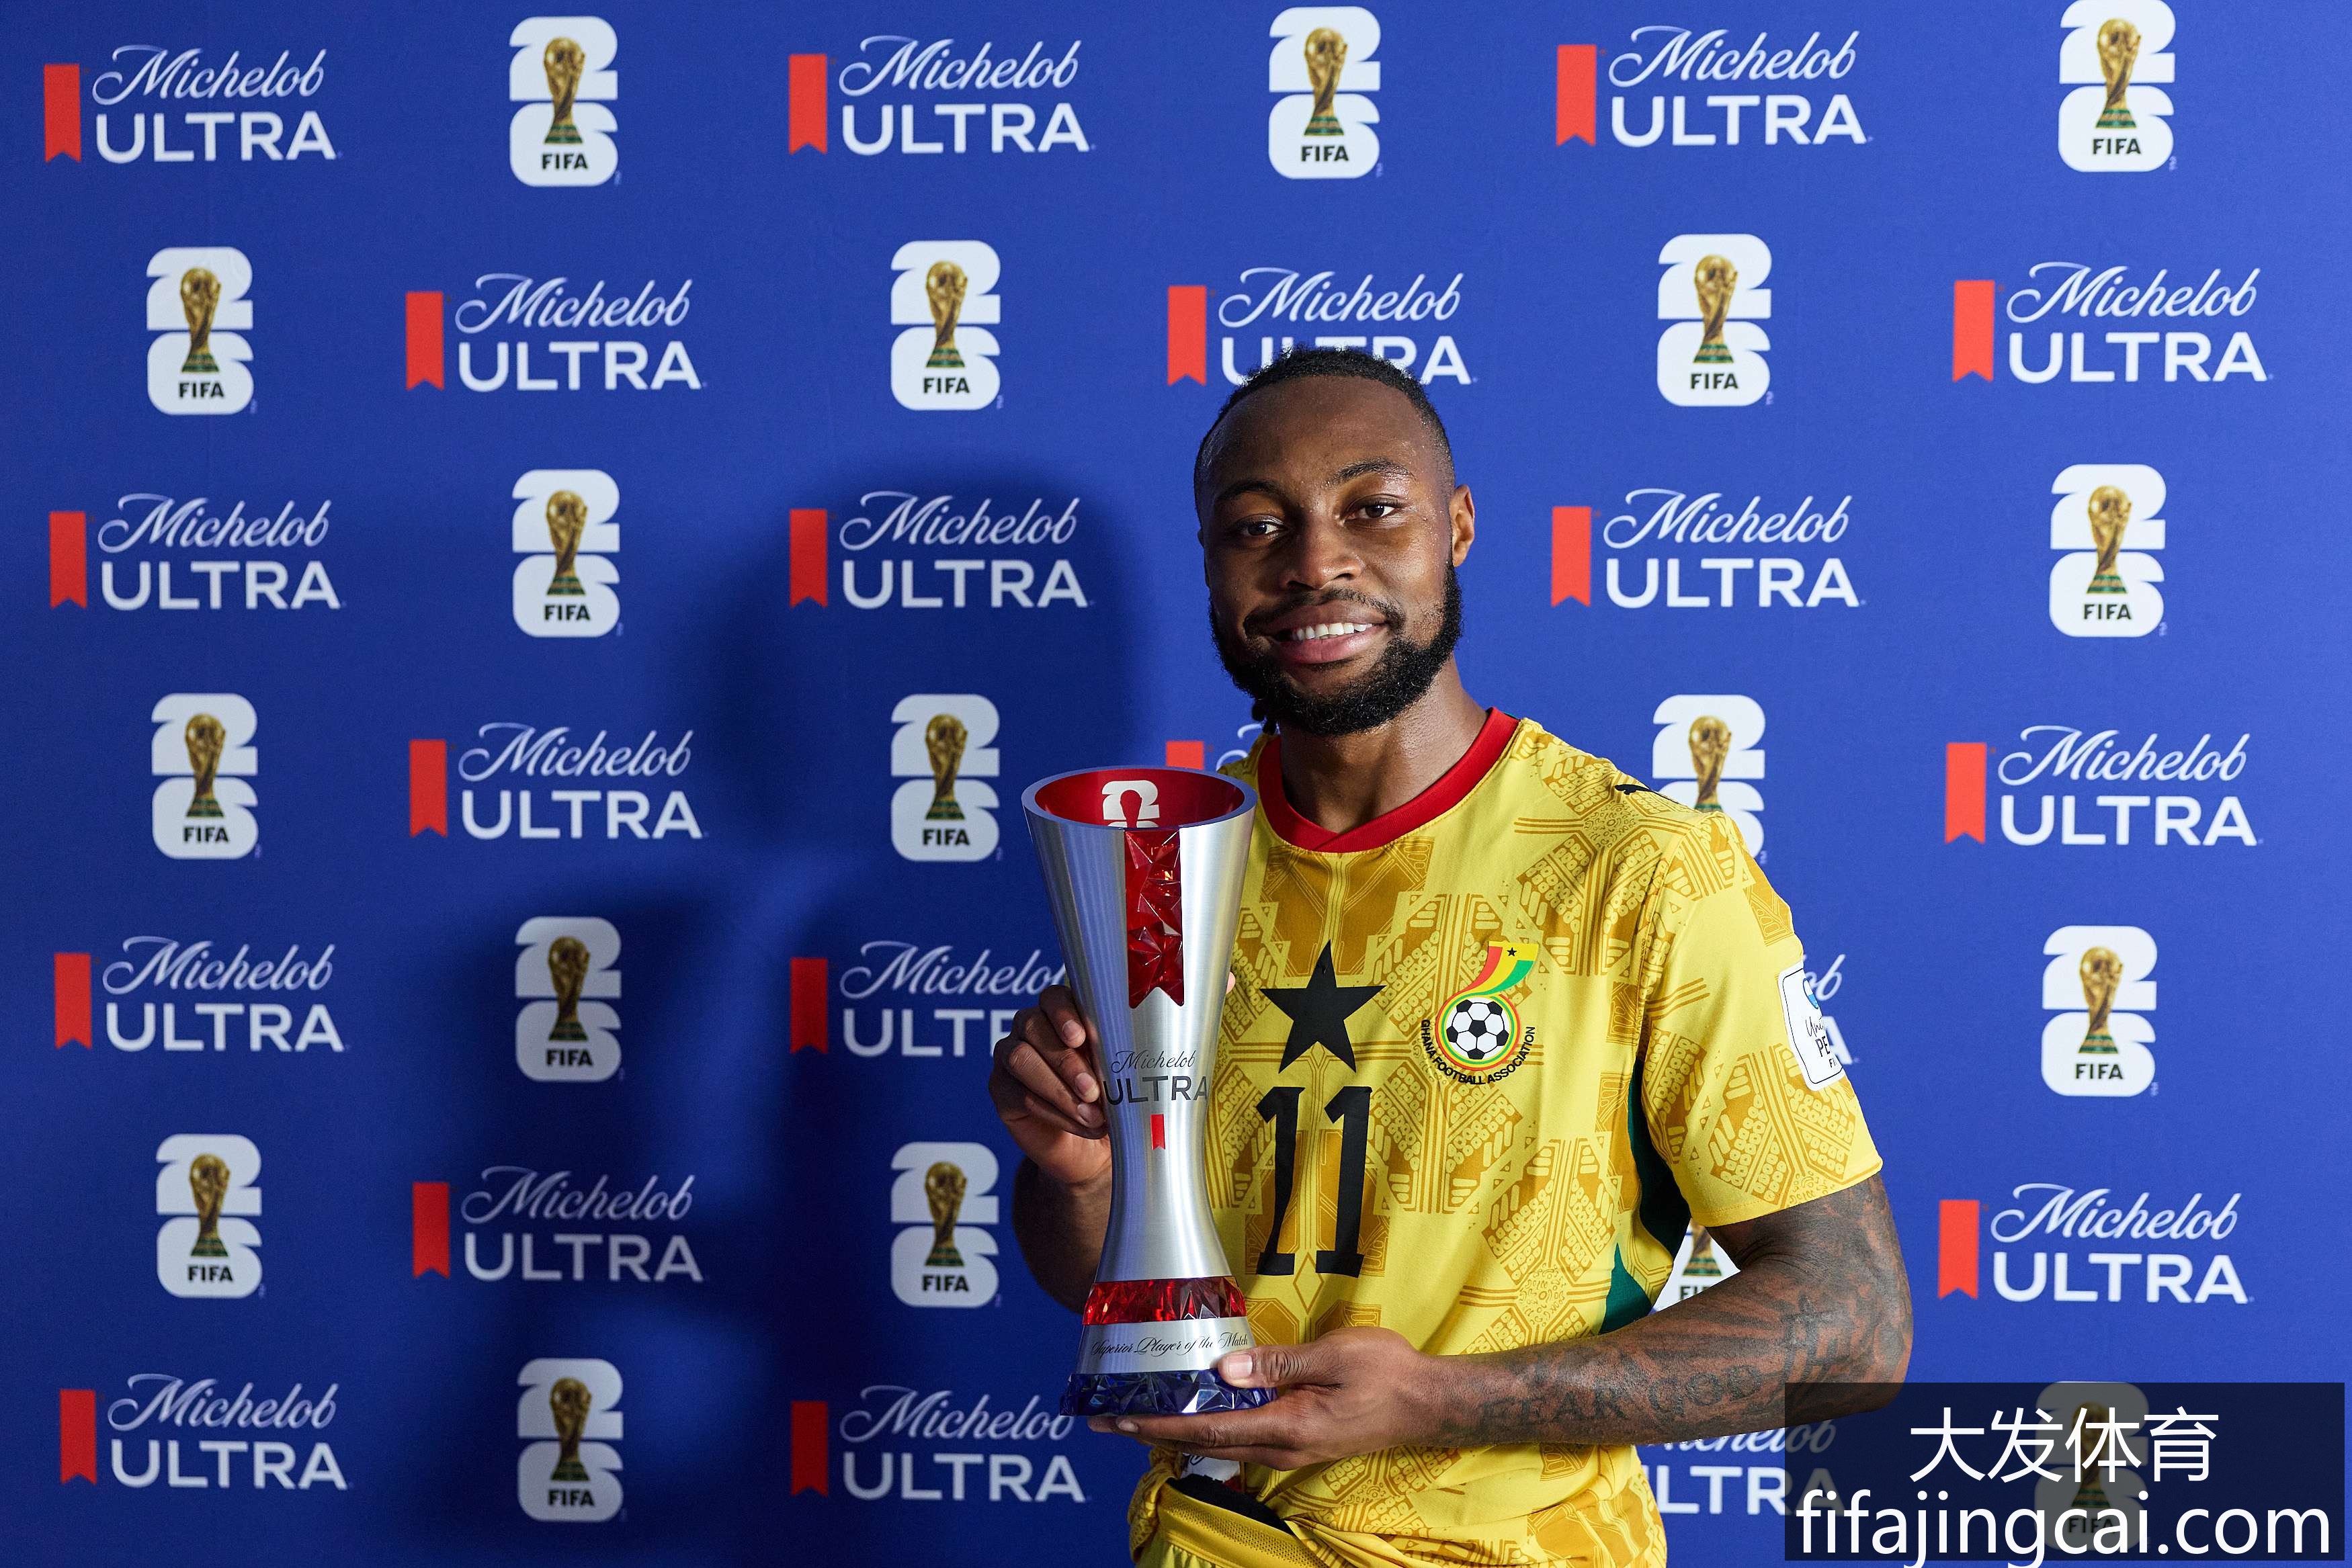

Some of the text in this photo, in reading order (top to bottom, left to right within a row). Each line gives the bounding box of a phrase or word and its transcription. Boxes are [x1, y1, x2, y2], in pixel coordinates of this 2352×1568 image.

[92, 46, 326, 105] Michelob
[839, 36, 1081, 96] Michelob
[1609, 26, 1859, 87] Michelob
[97, 112, 335, 163] ULTRA
[843, 103, 1089, 155] ULTRA
[1612, 95, 1866, 147] ULTRA
[542, 154, 587, 169] FIFA
[1302, 146, 1349, 161] FIFA
[2093, 138, 2141, 155] FIFA
[455, 273, 692, 333] Michelob
[1219, 267, 1463, 327] Michelob
[2007, 262, 2260, 323] Michelob
[459, 341, 701, 392] ULTRA
[1691, 374, 1738, 389] FIFA
[2010, 332, 2267, 383] ULTRA
[179, 382, 224, 398] FIFA
[924, 378, 970, 393] FIFA
[98, 494, 331, 553] Michelob
[839, 491, 1079, 550] Michelob
[1603, 488, 1852, 549] Michelob
[102, 562, 340, 610] ULTRA
[843, 560, 1087, 609] ULTRA
[1607, 558, 1859, 608] ULTRA
[545, 605, 590, 620] FIFA
[2084, 604, 2132, 619] FIFA
[459, 723, 693, 781] Michelob
[1999, 726, 2250, 785] Michelob
[184, 827, 228, 842] FIFA
[462, 790, 702, 838] ULTRA
[923, 829, 970, 845] FIFA
[2001, 795, 2257, 846] ULTRA
[103, 936, 335, 994] Michelob
[107, 1003, 344, 1051] ULTRA
[1421, 1019, 1536, 1085] GHANA FOOTBALL ASSOCIATION
[546, 1049, 593, 1066] FIFA
[1111, 1049, 1196, 1074] Michelob
[2076, 1064, 2123, 1079] FIFA
[1103, 1075, 1208, 1106] ULTRA
[461, 1166, 695, 1223] Michelob
[1255, 1086, 1373, 1278] 11
[1991, 1183, 2241, 1242] Michelob
[188, 1266, 233, 1282] FIFA
[465, 1233, 702, 1281] ULTRA
[1994, 1252, 2248, 1303] ULTRA
[922, 1275, 969, 1292] FIFA
[1091, 1339, 1134, 1360] Superior
[1134, 1336, 1182, 1357] Player
[1177, 1336, 1198, 1356] of
[1218, 1332, 1249, 1349] Match
[108, 1374, 338, 1431] Michelob
[1648, 1364, 1763, 1418] GOD
[112, 1440, 346, 1489] ULTRA
[845, 1452, 1085, 1502] ULTRA
[548, 1489, 594, 1506] FIFA
[1642, 1465, 1845, 1516] LTRA
